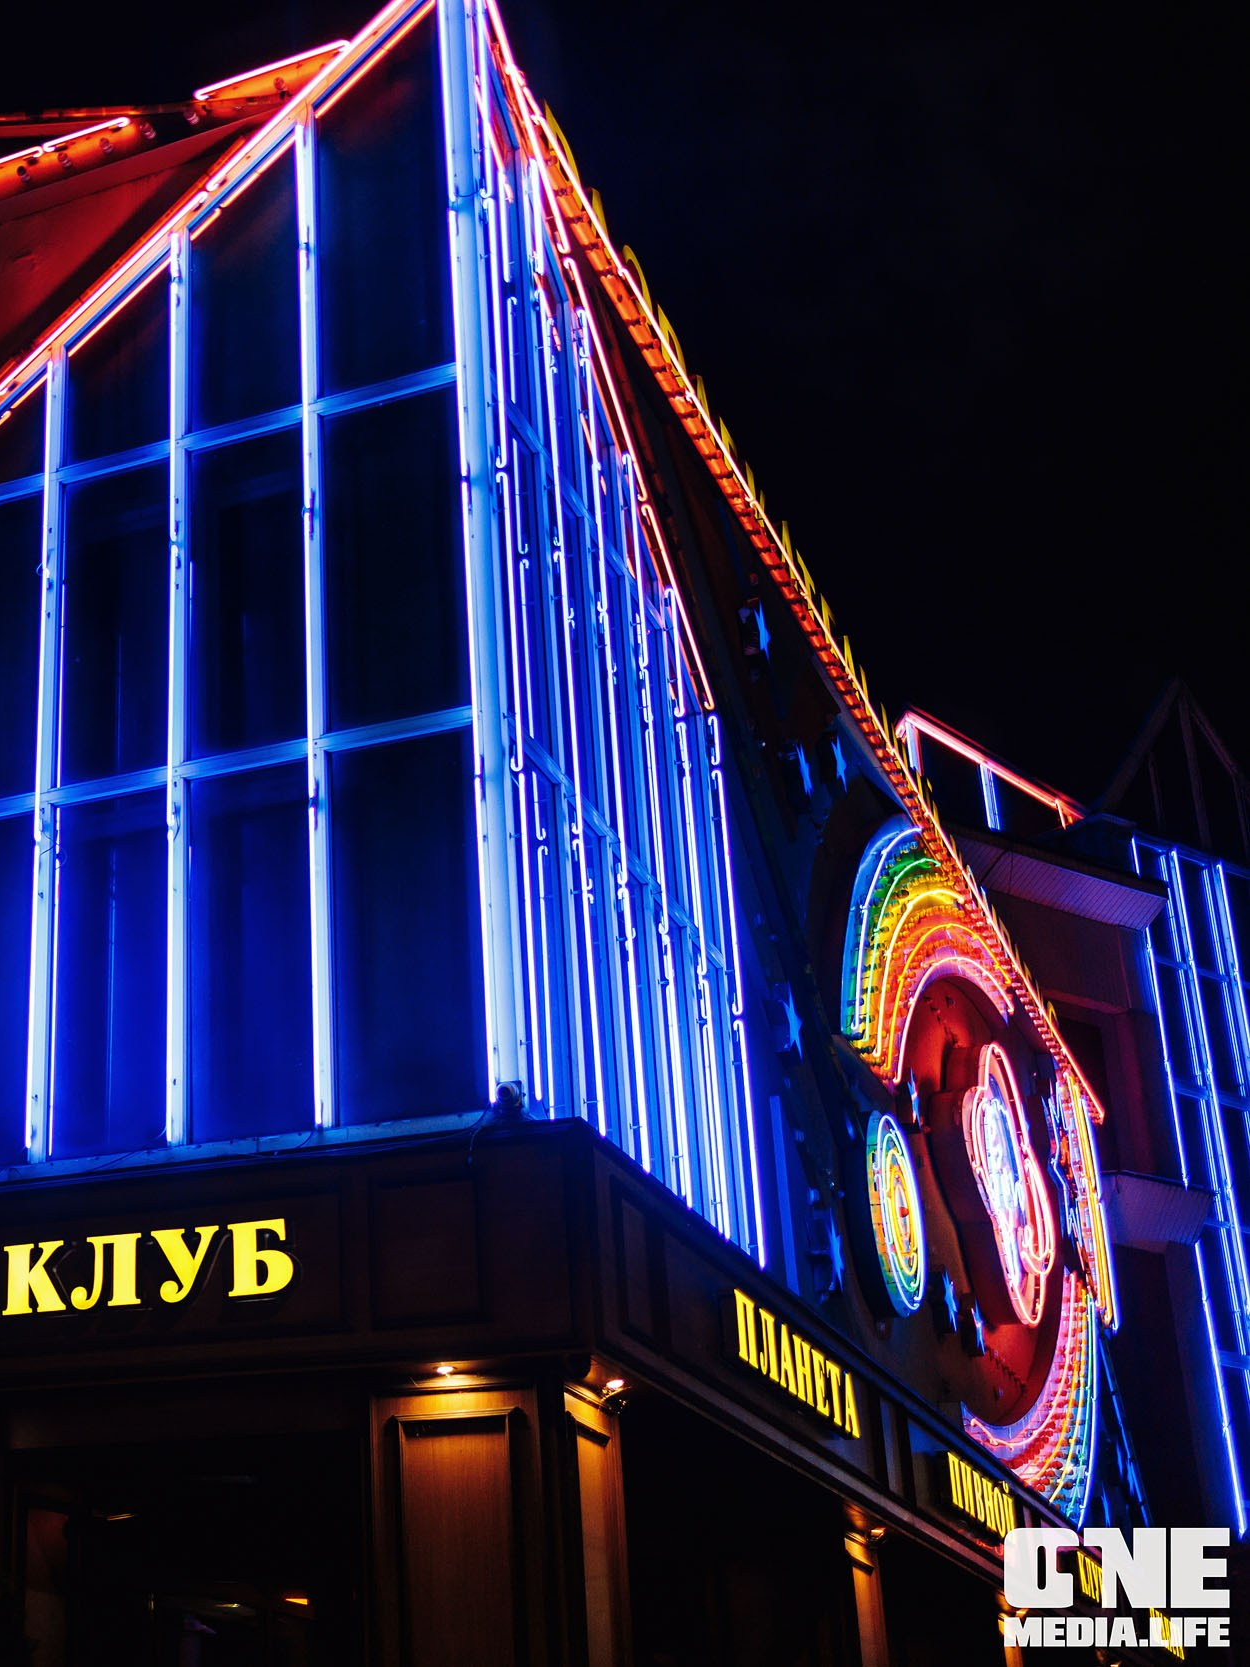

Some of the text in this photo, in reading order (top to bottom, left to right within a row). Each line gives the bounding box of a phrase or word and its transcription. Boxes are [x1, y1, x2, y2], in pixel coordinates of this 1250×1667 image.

[2, 1218, 295, 1316] КЛУБ
[733, 1288, 861, 1439] ПЛАНЕТА
[947, 1452, 1016, 1540] ПИВНОЙ
